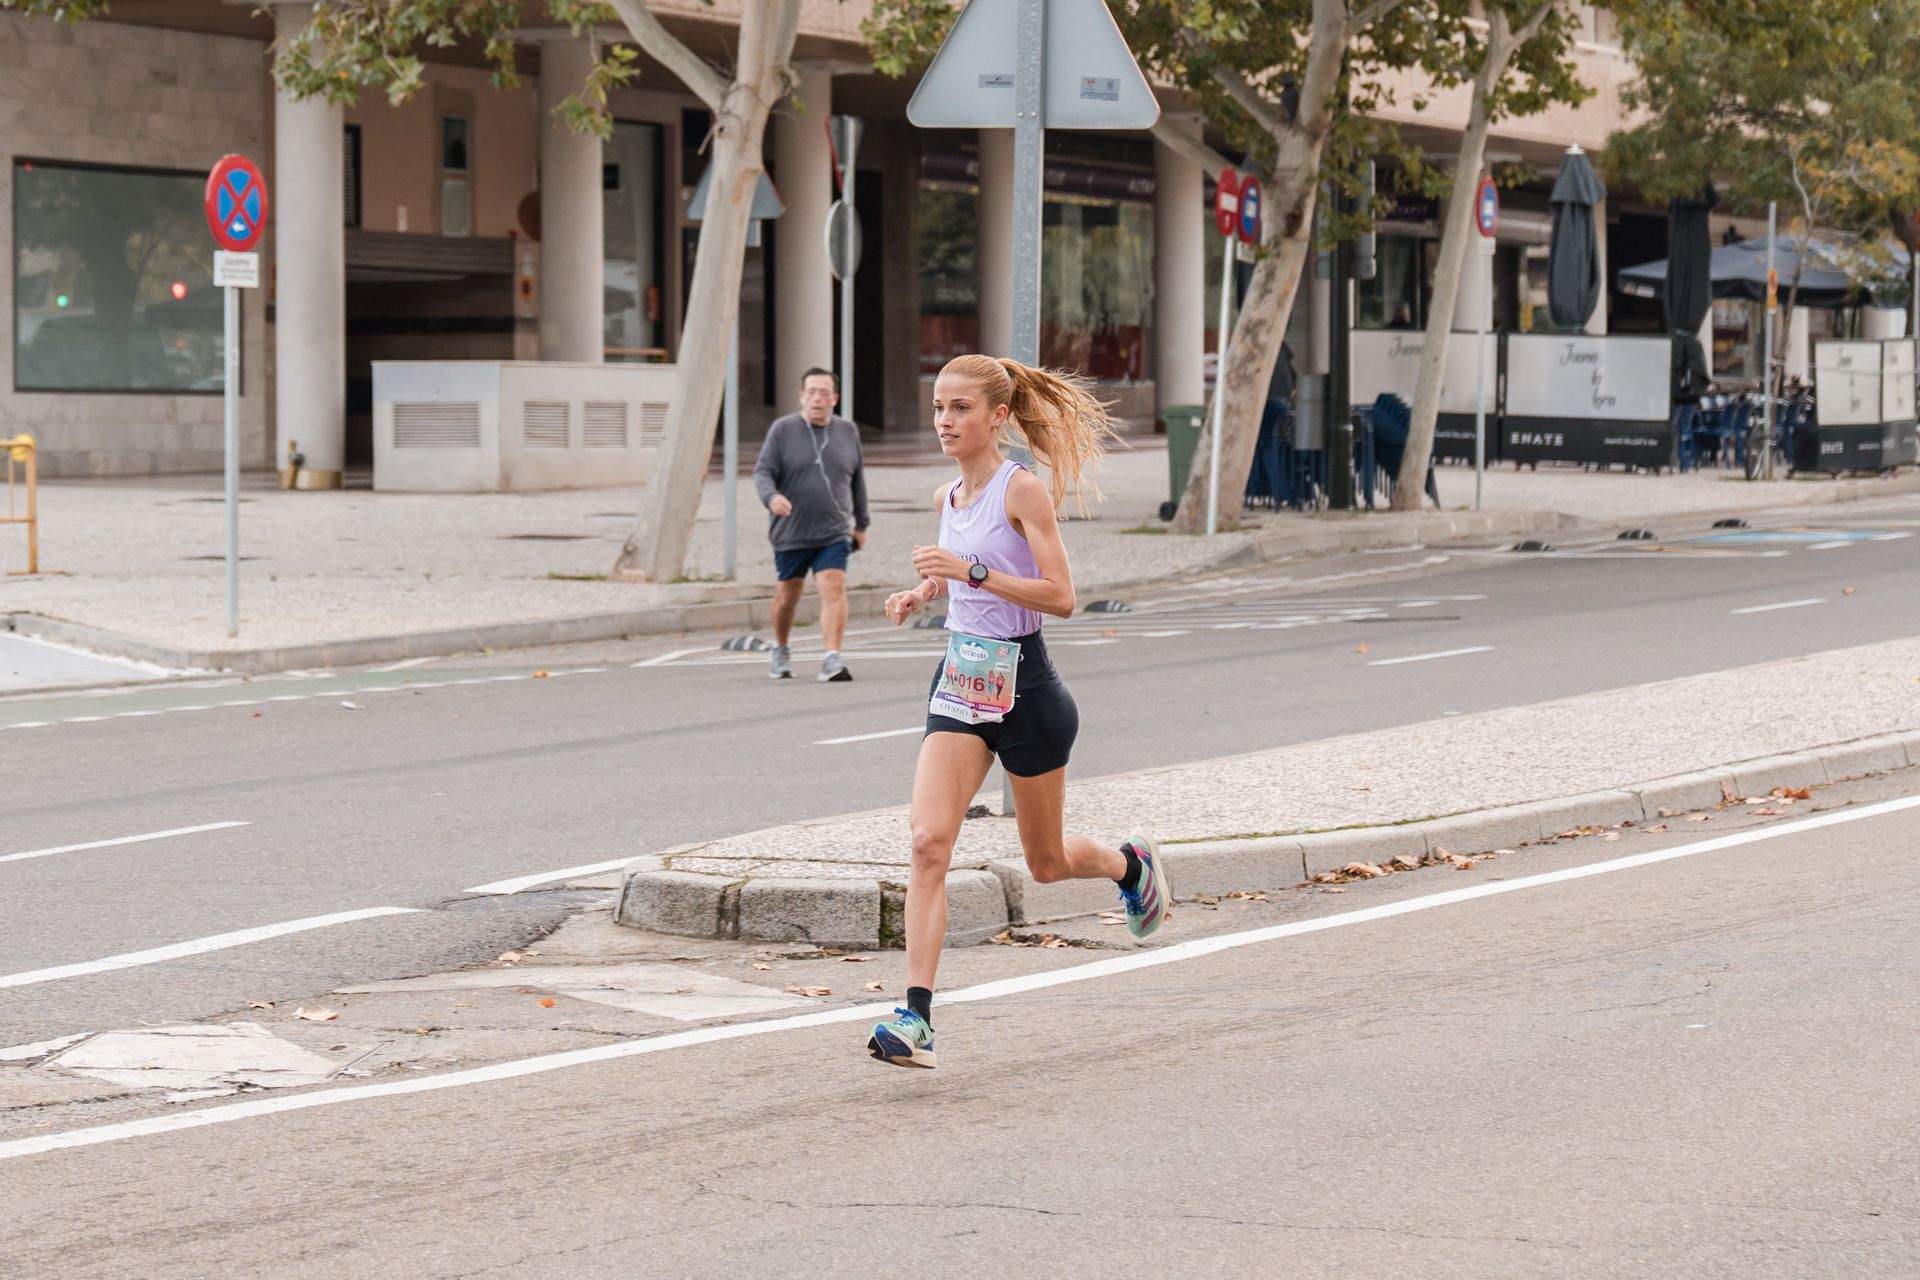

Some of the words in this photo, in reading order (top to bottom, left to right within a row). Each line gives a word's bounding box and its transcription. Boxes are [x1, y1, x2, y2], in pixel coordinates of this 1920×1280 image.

[1559, 343, 1599, 367] Juana
[1510, 431, 1564, 446] ENATE
[959, 674, 984, 691] 016
